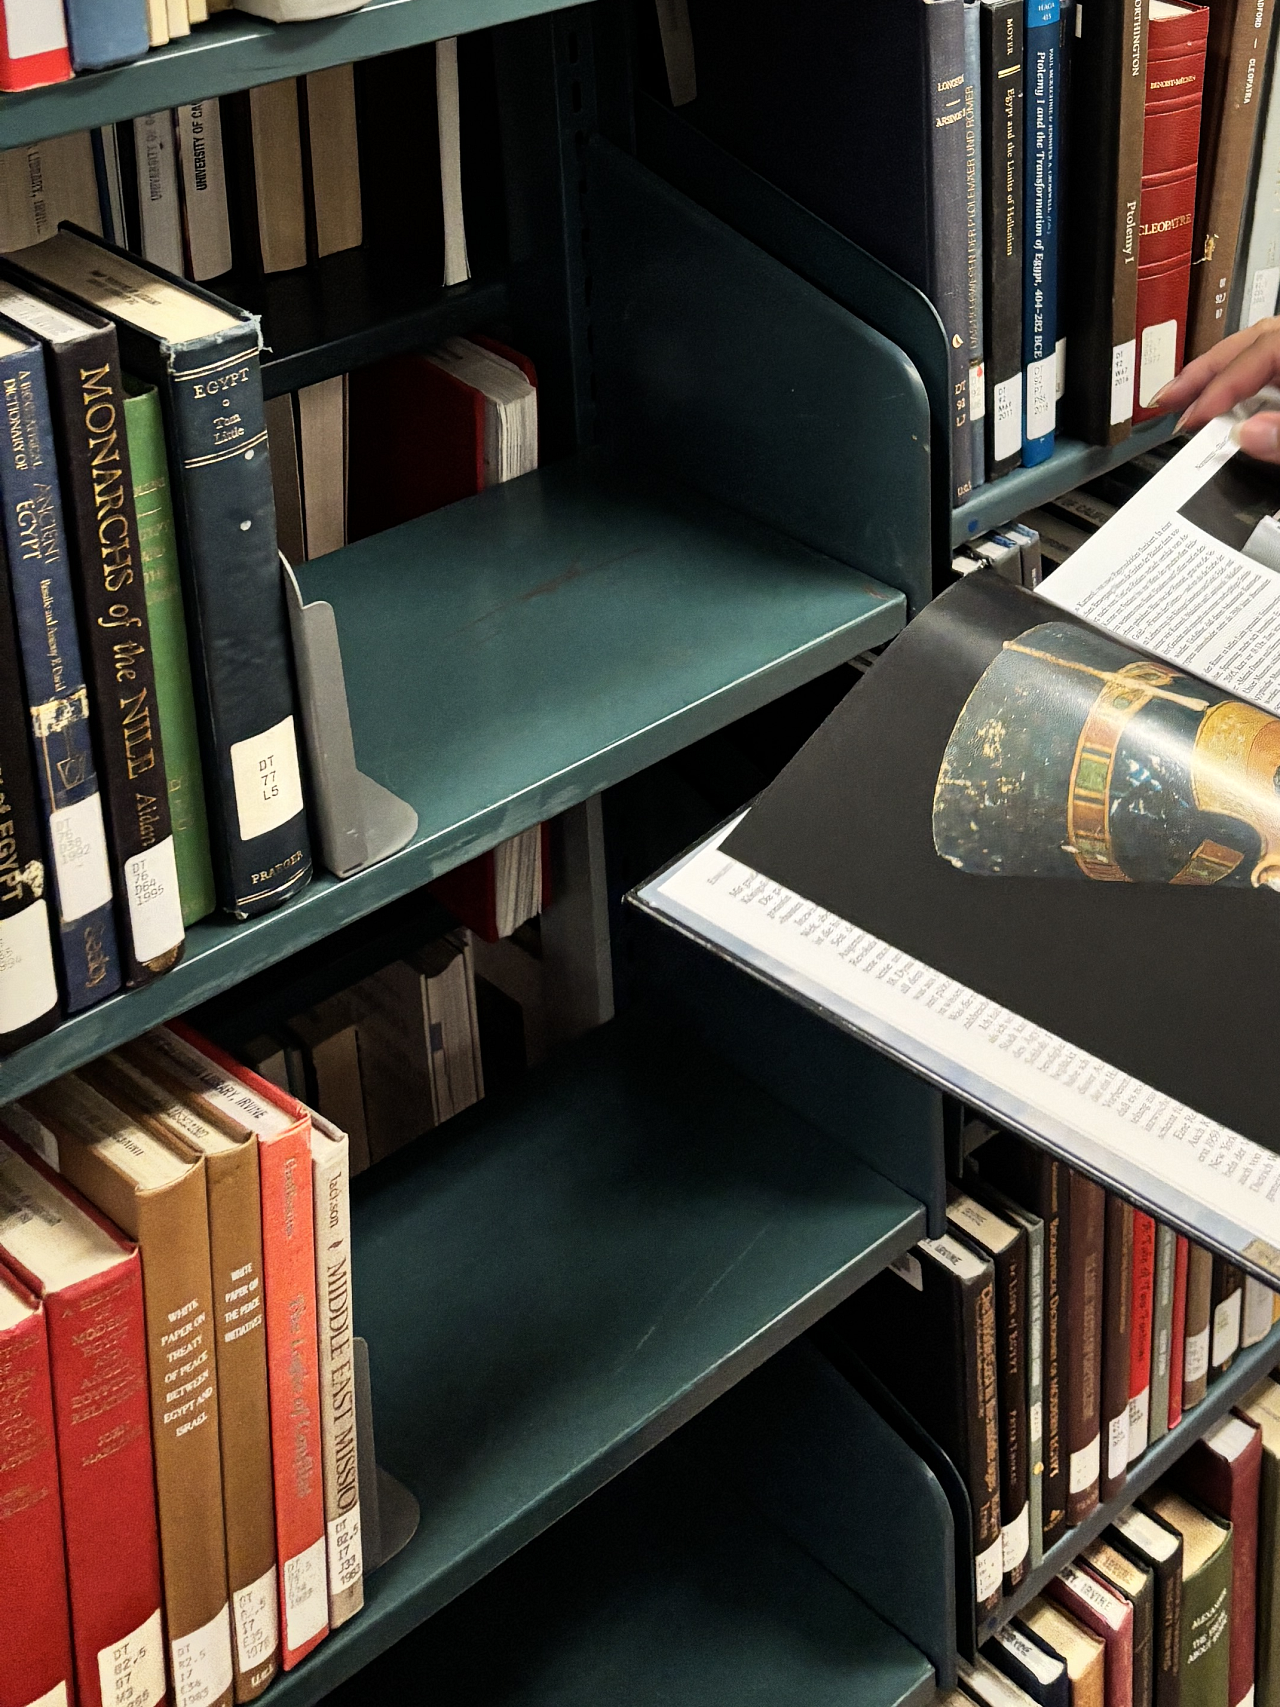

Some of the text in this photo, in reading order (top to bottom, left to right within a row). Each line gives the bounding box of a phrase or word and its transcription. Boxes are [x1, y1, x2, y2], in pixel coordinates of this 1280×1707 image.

[1006, 18, 1014, 55] MOYER
[1244, 58, 1257, 105] CLEOPATRA
[192, 120, 208, 191] UNIVERSITY OF
[1005, 88, 1016, 205] Egypt and the Limits of
[1032, 51, 1046, 358] Ptolemy and the Transformation of Egypt, BCE
[1125, 201, 1137, 255] Ptolemy
[193, 367, 250, 400] EGYPT
[213, 414, 242, 431] Tom
[213, 426, 245, 445] Little
[80, 363, 134, 592] MONARCHS
[15, 500, 42, 561] EGYPT
[98, 603, 142, 628] of
[112, 640, 145, 683] the
[119, 687, 155, 779] NILE
[258, 755, 275, 772] DT
[260, 771, 277, 785] 77
[262, 785, 280, 802] L5
[327, 1257, 352, 1361] MIDDLE
[160, 1320, 191, 1347] PAPER
[166, 1336, 203, 1363] TREATY
[164, 1350, 208, 1385] OF PEACE
[163, 1396, 195, 1424] EGYPT
[331, 1361, 355, 1427] EAST
[175, 1412, 208, 1438] ISRAEL
